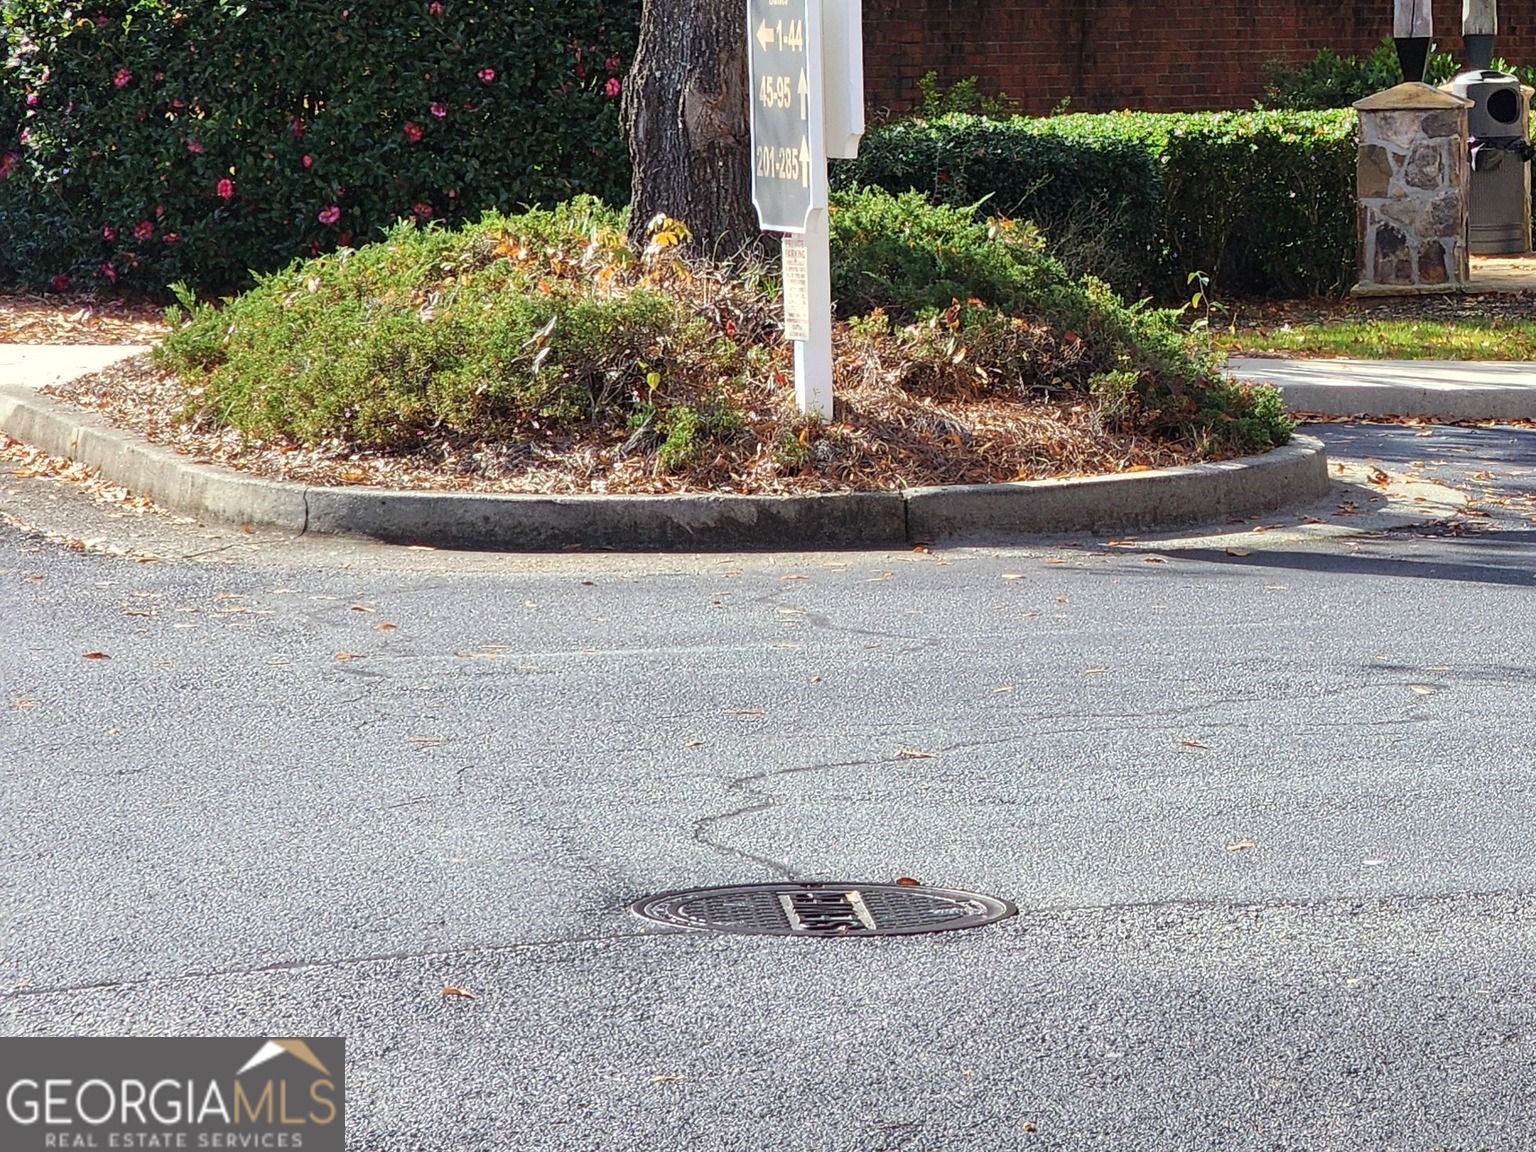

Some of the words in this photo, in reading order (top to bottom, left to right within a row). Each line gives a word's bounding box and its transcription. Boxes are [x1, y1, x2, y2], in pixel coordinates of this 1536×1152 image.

[776, 19, 803, 52] 1-44
[760, 75, 791, 108] 45-95
[757, 145, 799, 180] 201-285
